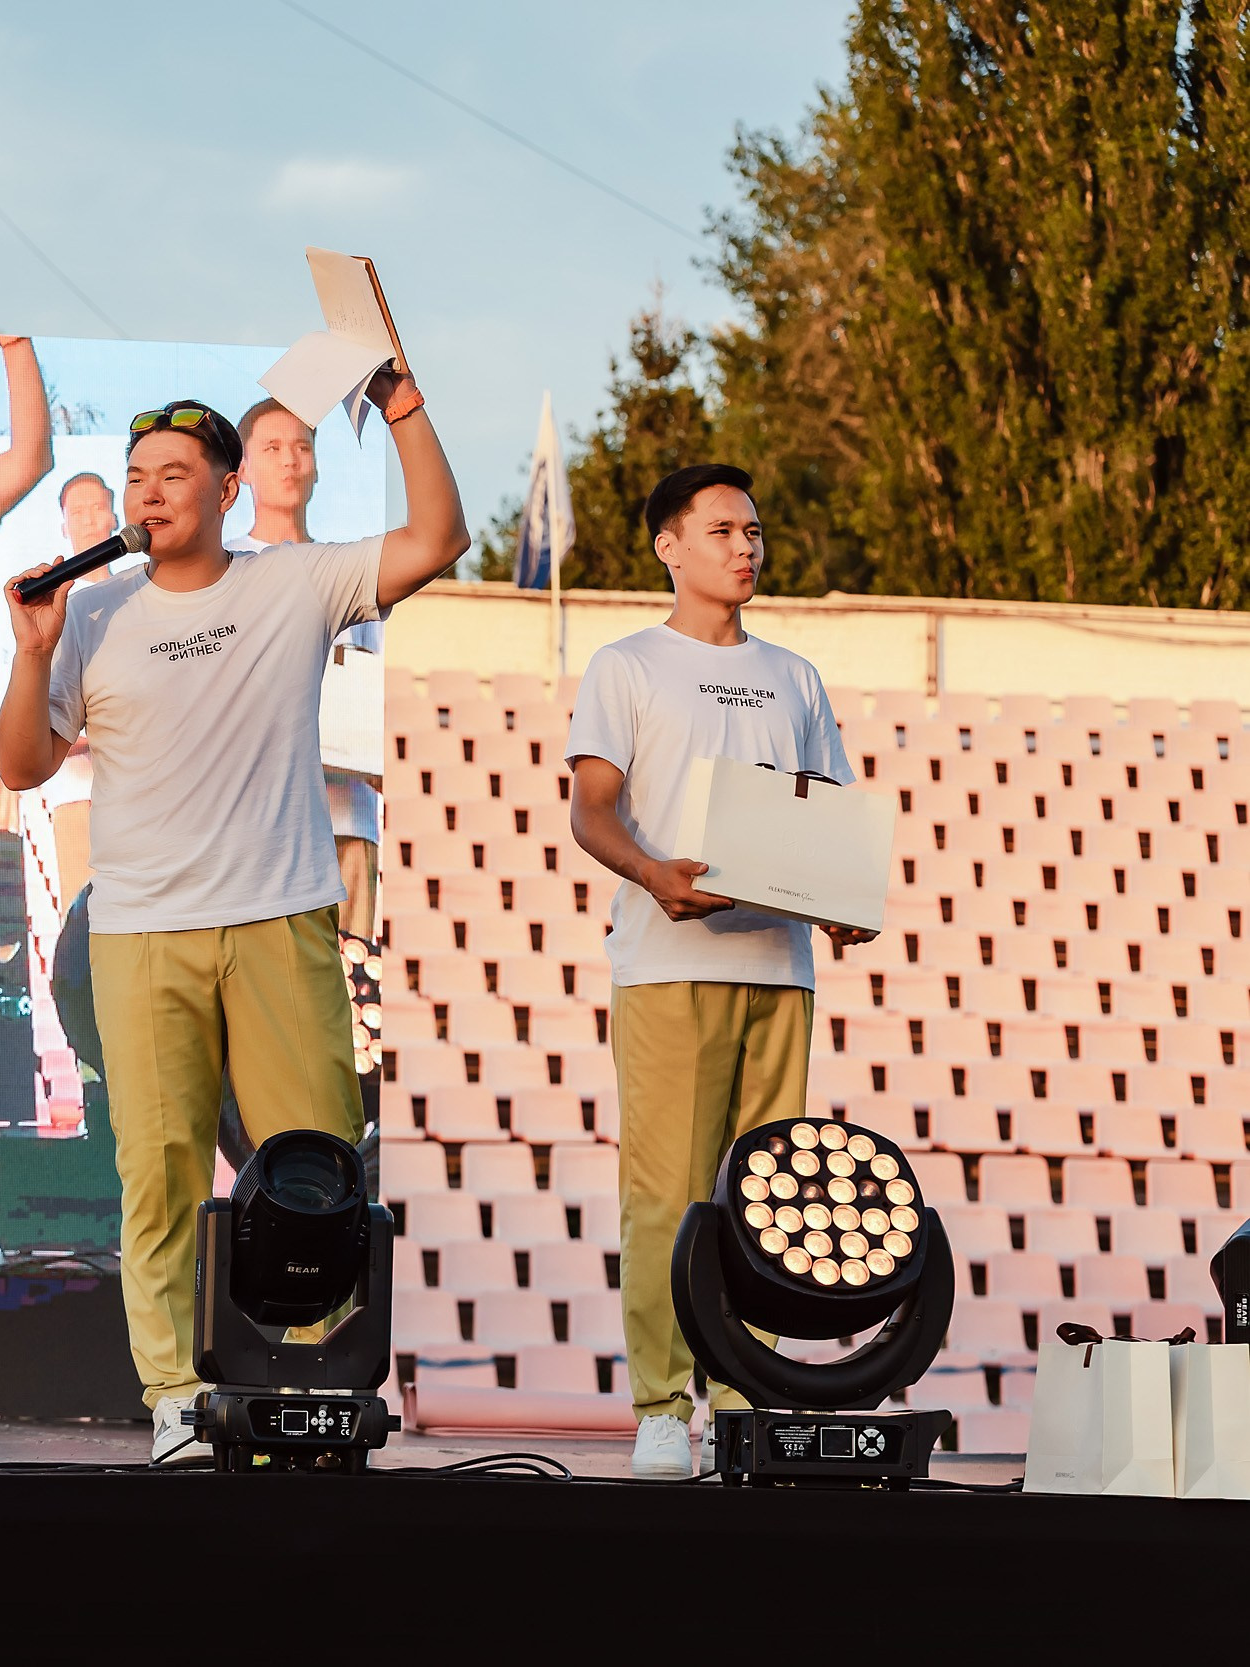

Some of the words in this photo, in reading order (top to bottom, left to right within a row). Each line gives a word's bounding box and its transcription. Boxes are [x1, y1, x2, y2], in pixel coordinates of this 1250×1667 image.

[150, 632, 206, 654] БОЛЬШЕ
[208, 624, 237, 639] ЧЕМ
[168, 641, 222, 661] ФИТНЕС
[699, 684, 749, 697] БОЛЬШЕ
[751, 688, 776, 700] ЧЕМ
[716, 696, 764, 708] ФИТНЕС
[287, 1265, 319, 1274] BEAM
